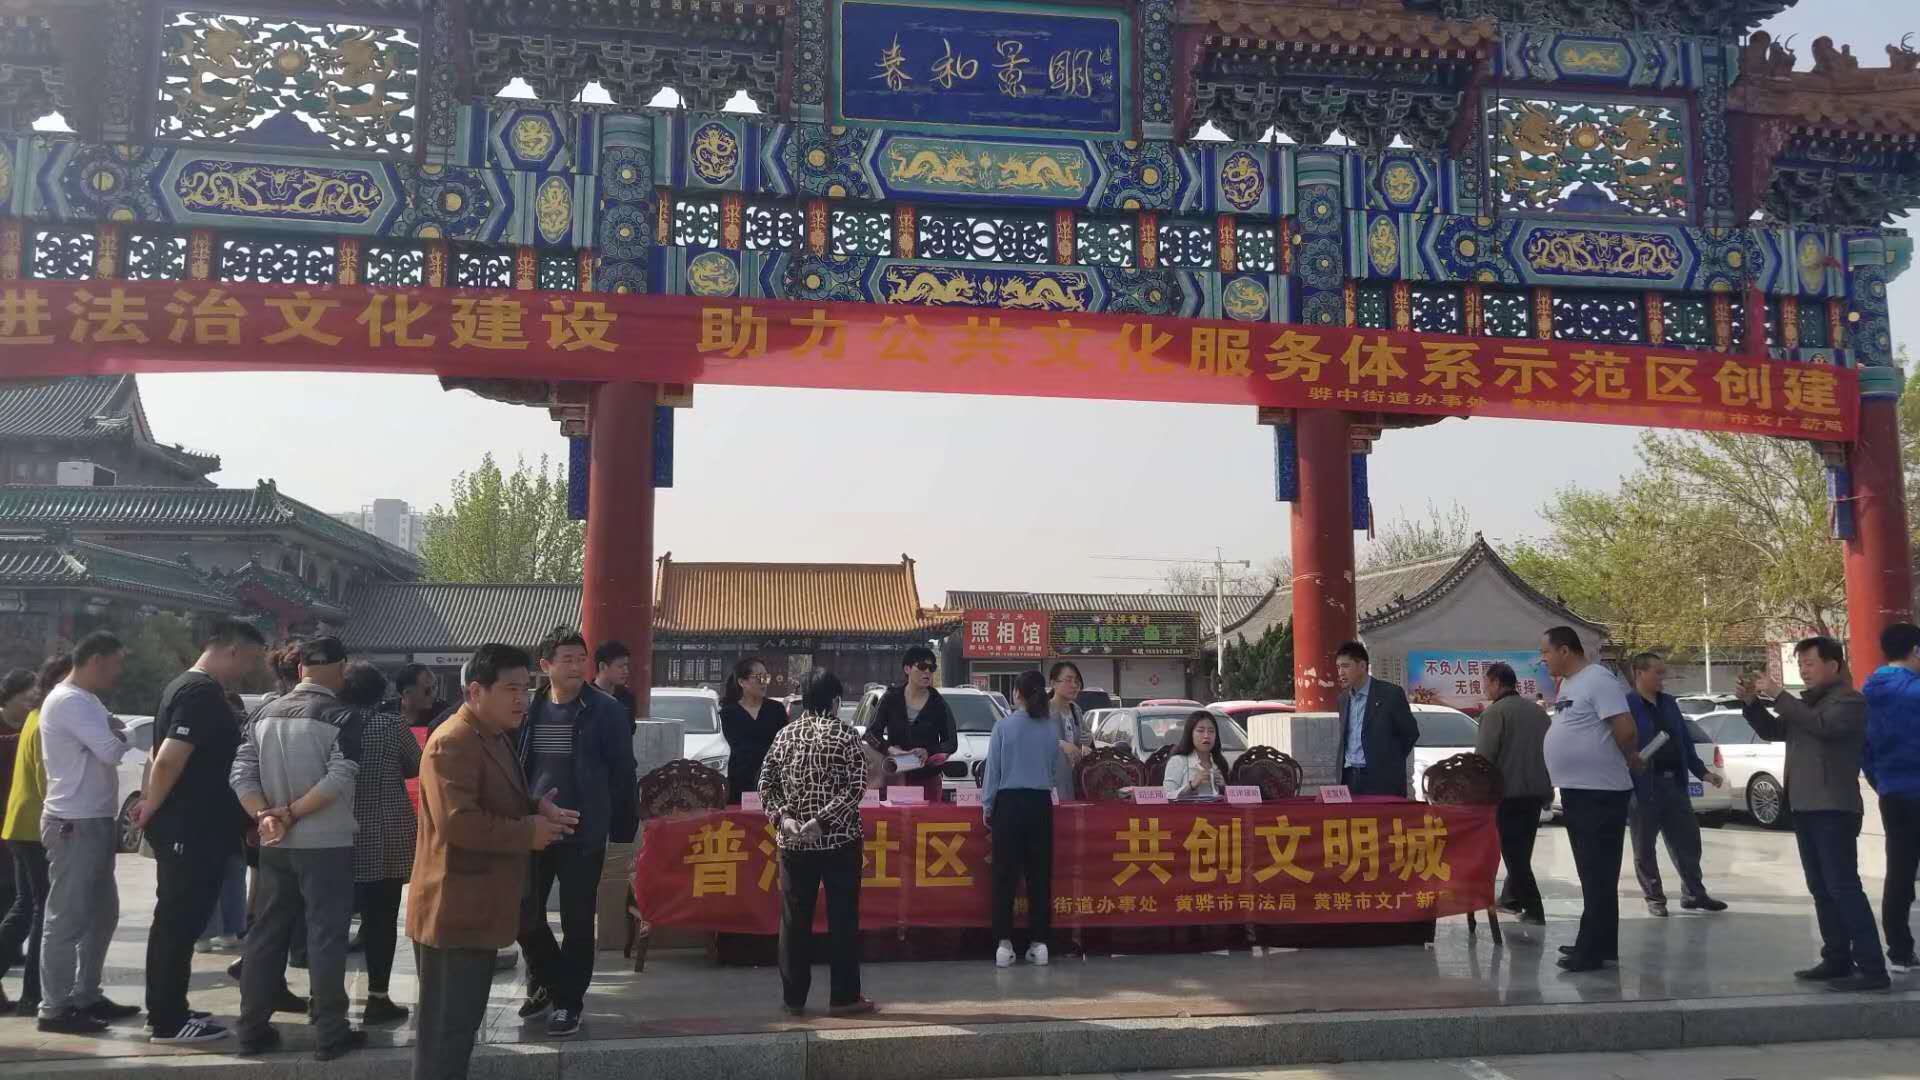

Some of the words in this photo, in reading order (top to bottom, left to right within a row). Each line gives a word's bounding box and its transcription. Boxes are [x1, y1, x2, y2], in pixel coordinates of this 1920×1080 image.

[0, 286, 622, 353] 进法治文化建设
[697, 306, 1842, 416] 助力公共文化服务体系示范区创建
[971, 621, 1041, 645] 照相馆
[1425, 660, 1506, 676] 不负人民重
[1455, 680, 1537, 695] 无愧选择
[1112, 814, 1452, 888] 共创文明城
[1175, 893, 1296, 913] 黄骅市司法局
